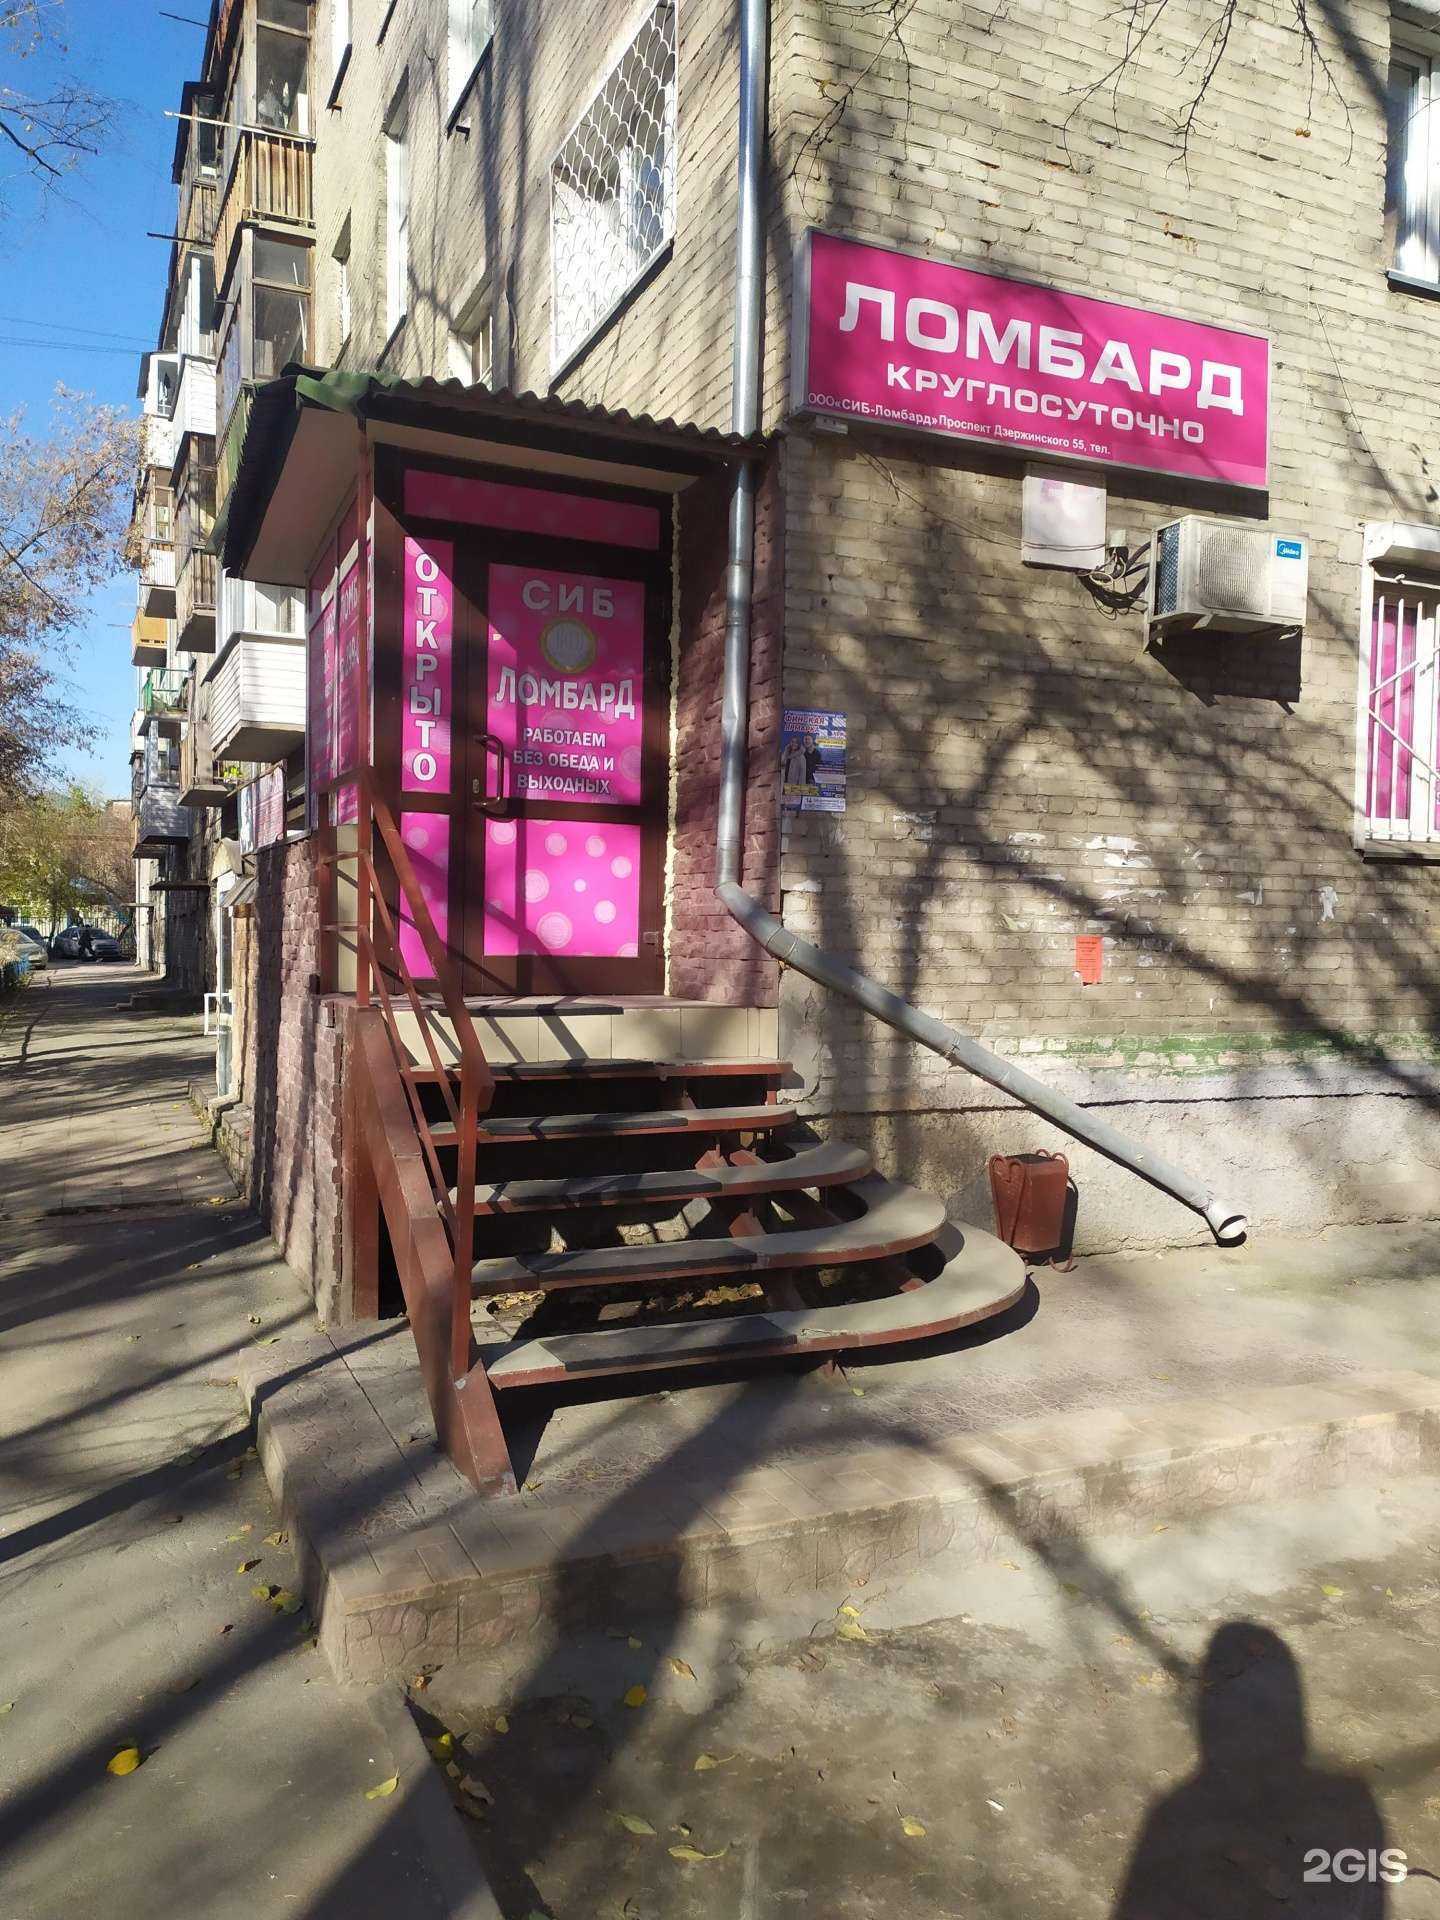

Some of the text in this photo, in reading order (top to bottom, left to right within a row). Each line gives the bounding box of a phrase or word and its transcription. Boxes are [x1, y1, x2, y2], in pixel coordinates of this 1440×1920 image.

[839, 281, 1244, 416] ЛОМБАРД
[887, 363, 1204, 445] КРУГЛОСУТОЧНО
[939, 414, 991, 434] Проспект
[994, 425, 1070, 448] Дзержинского
[1072, 438, 1087, 452] 55,
[1090, 443, 1111, 455] тел.
[522, 579, 615, 618] СИБ
[409, 553, 441, 781] ОТКРЫТО
[496, 667, 636, 720] ЛОМБАРД
[523, 727, 606, 748] РАБОТАЕМ
[513, 750, 614, 772] БЕЗ ОБЕДА И
[517, 773, 611, 795] ВЫХОДНЫХ
